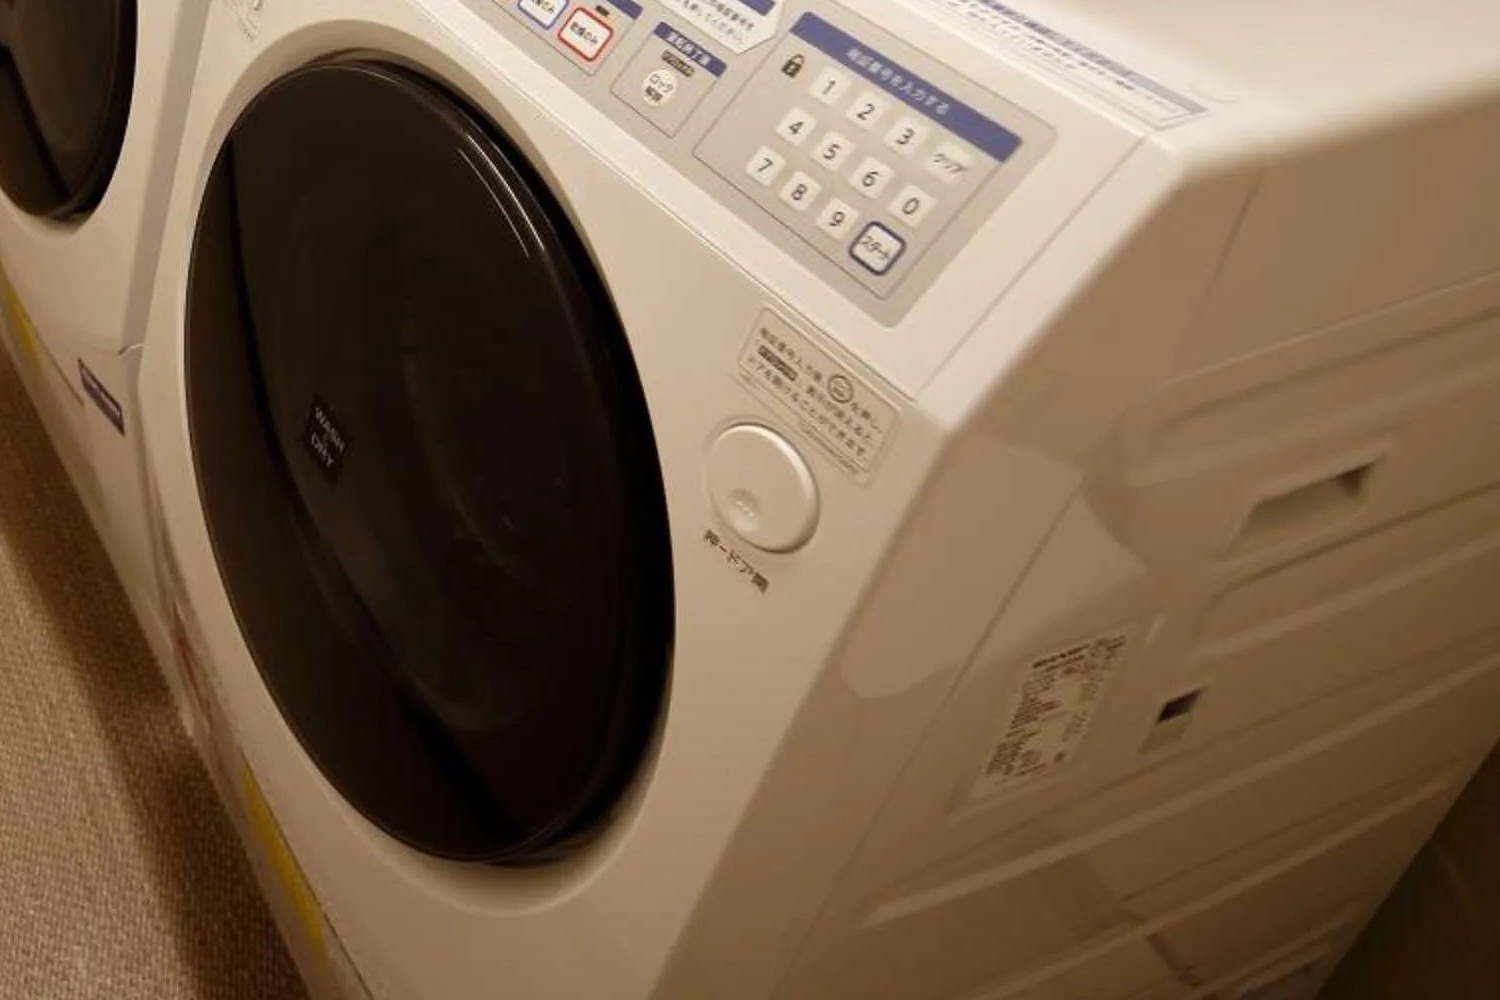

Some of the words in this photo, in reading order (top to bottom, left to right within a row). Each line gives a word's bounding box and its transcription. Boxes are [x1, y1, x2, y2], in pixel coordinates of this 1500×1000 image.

[823, 79, 836, 94] 1
[856, 103, 876, 121] 2
[789, 120, 804, 135] 4
[896, 127, 915, 146] 3
[823, 144, 840, 161] 5
[757, 157, 773, 174] 7
[862, 170, 878, 188] 6
[791, 183, 808, 201] 8
[901, 197, 920, 215] 0
[828, 211, 846, 227] 9
